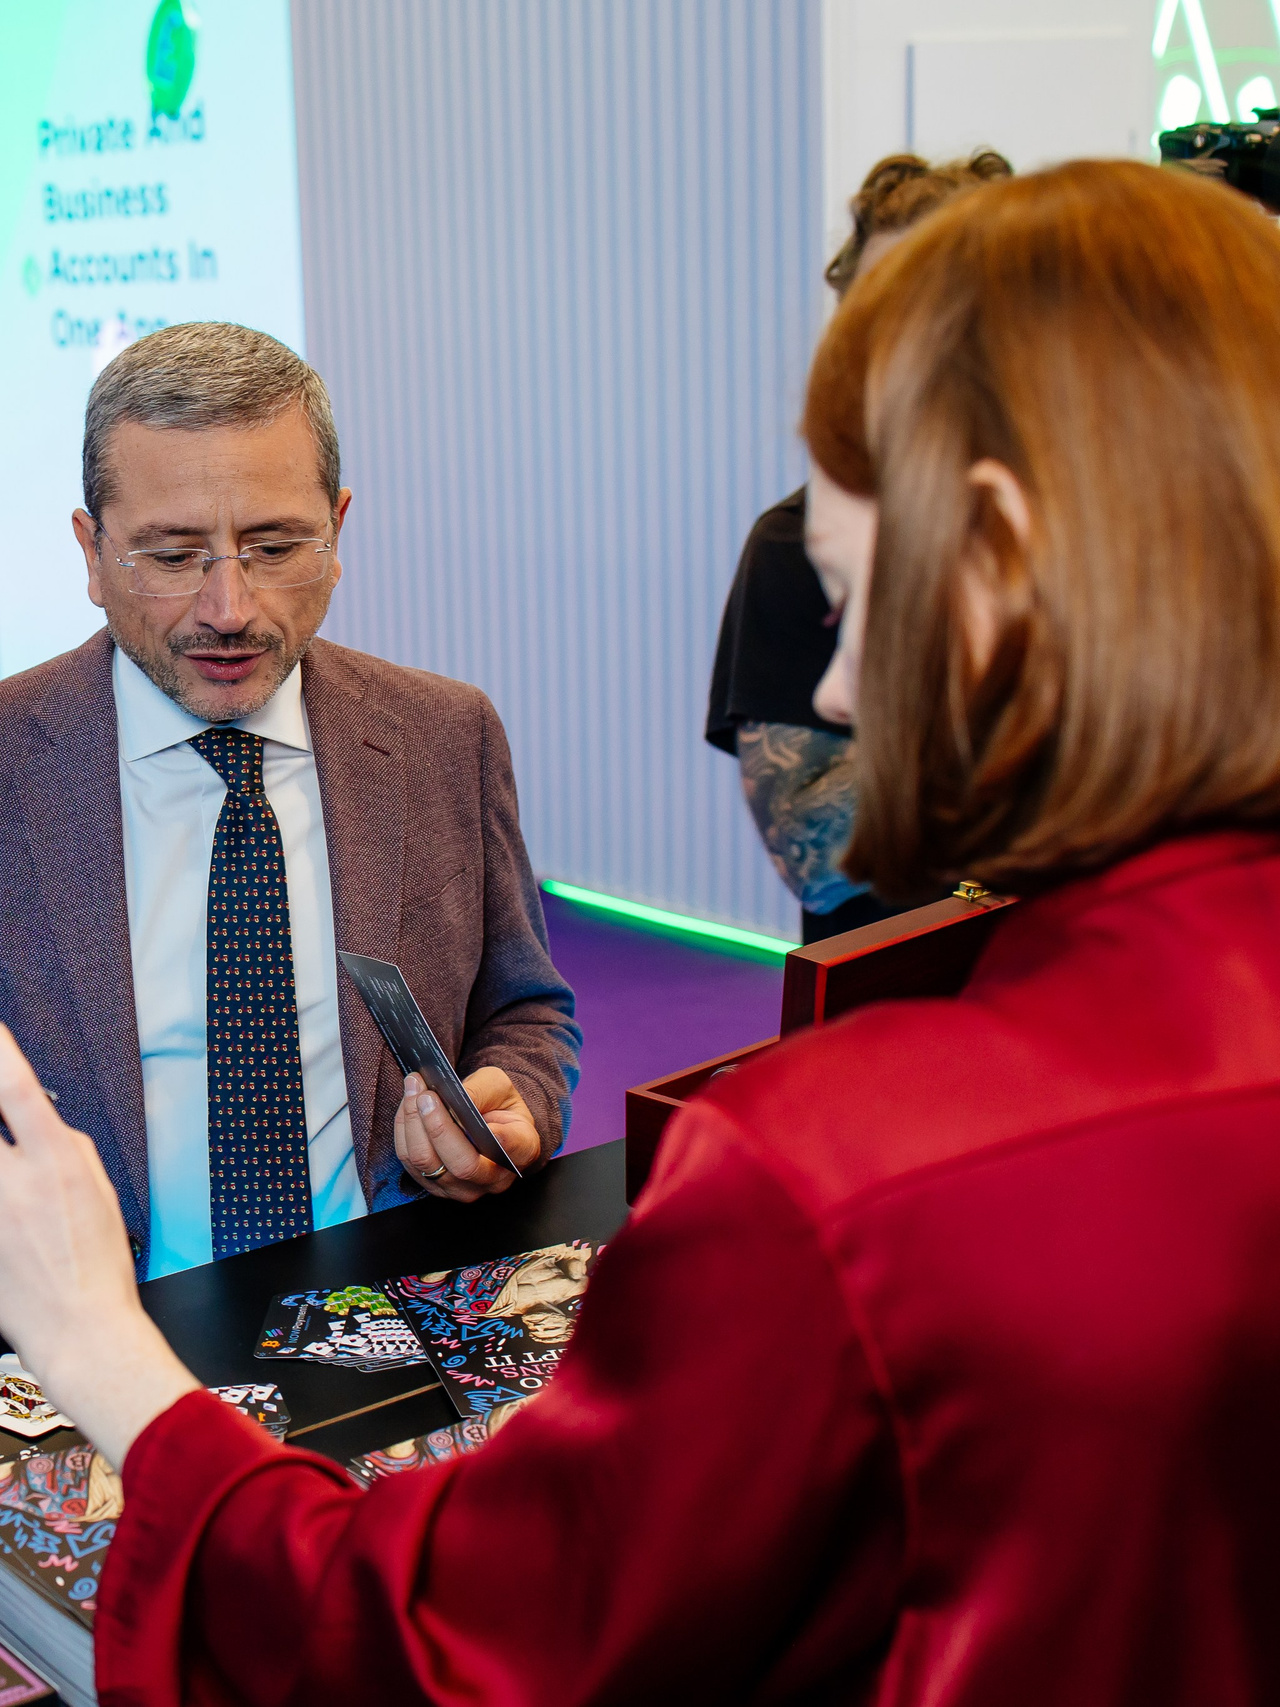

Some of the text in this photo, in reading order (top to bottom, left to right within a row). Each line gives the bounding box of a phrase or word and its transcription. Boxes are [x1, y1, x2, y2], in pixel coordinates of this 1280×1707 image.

[37, 98, 204, 156] Private And
[43, 180, 168, 223] Business
[50, 245, 177, 284] Accounts
[484, 1354, 517, 1368] IT
